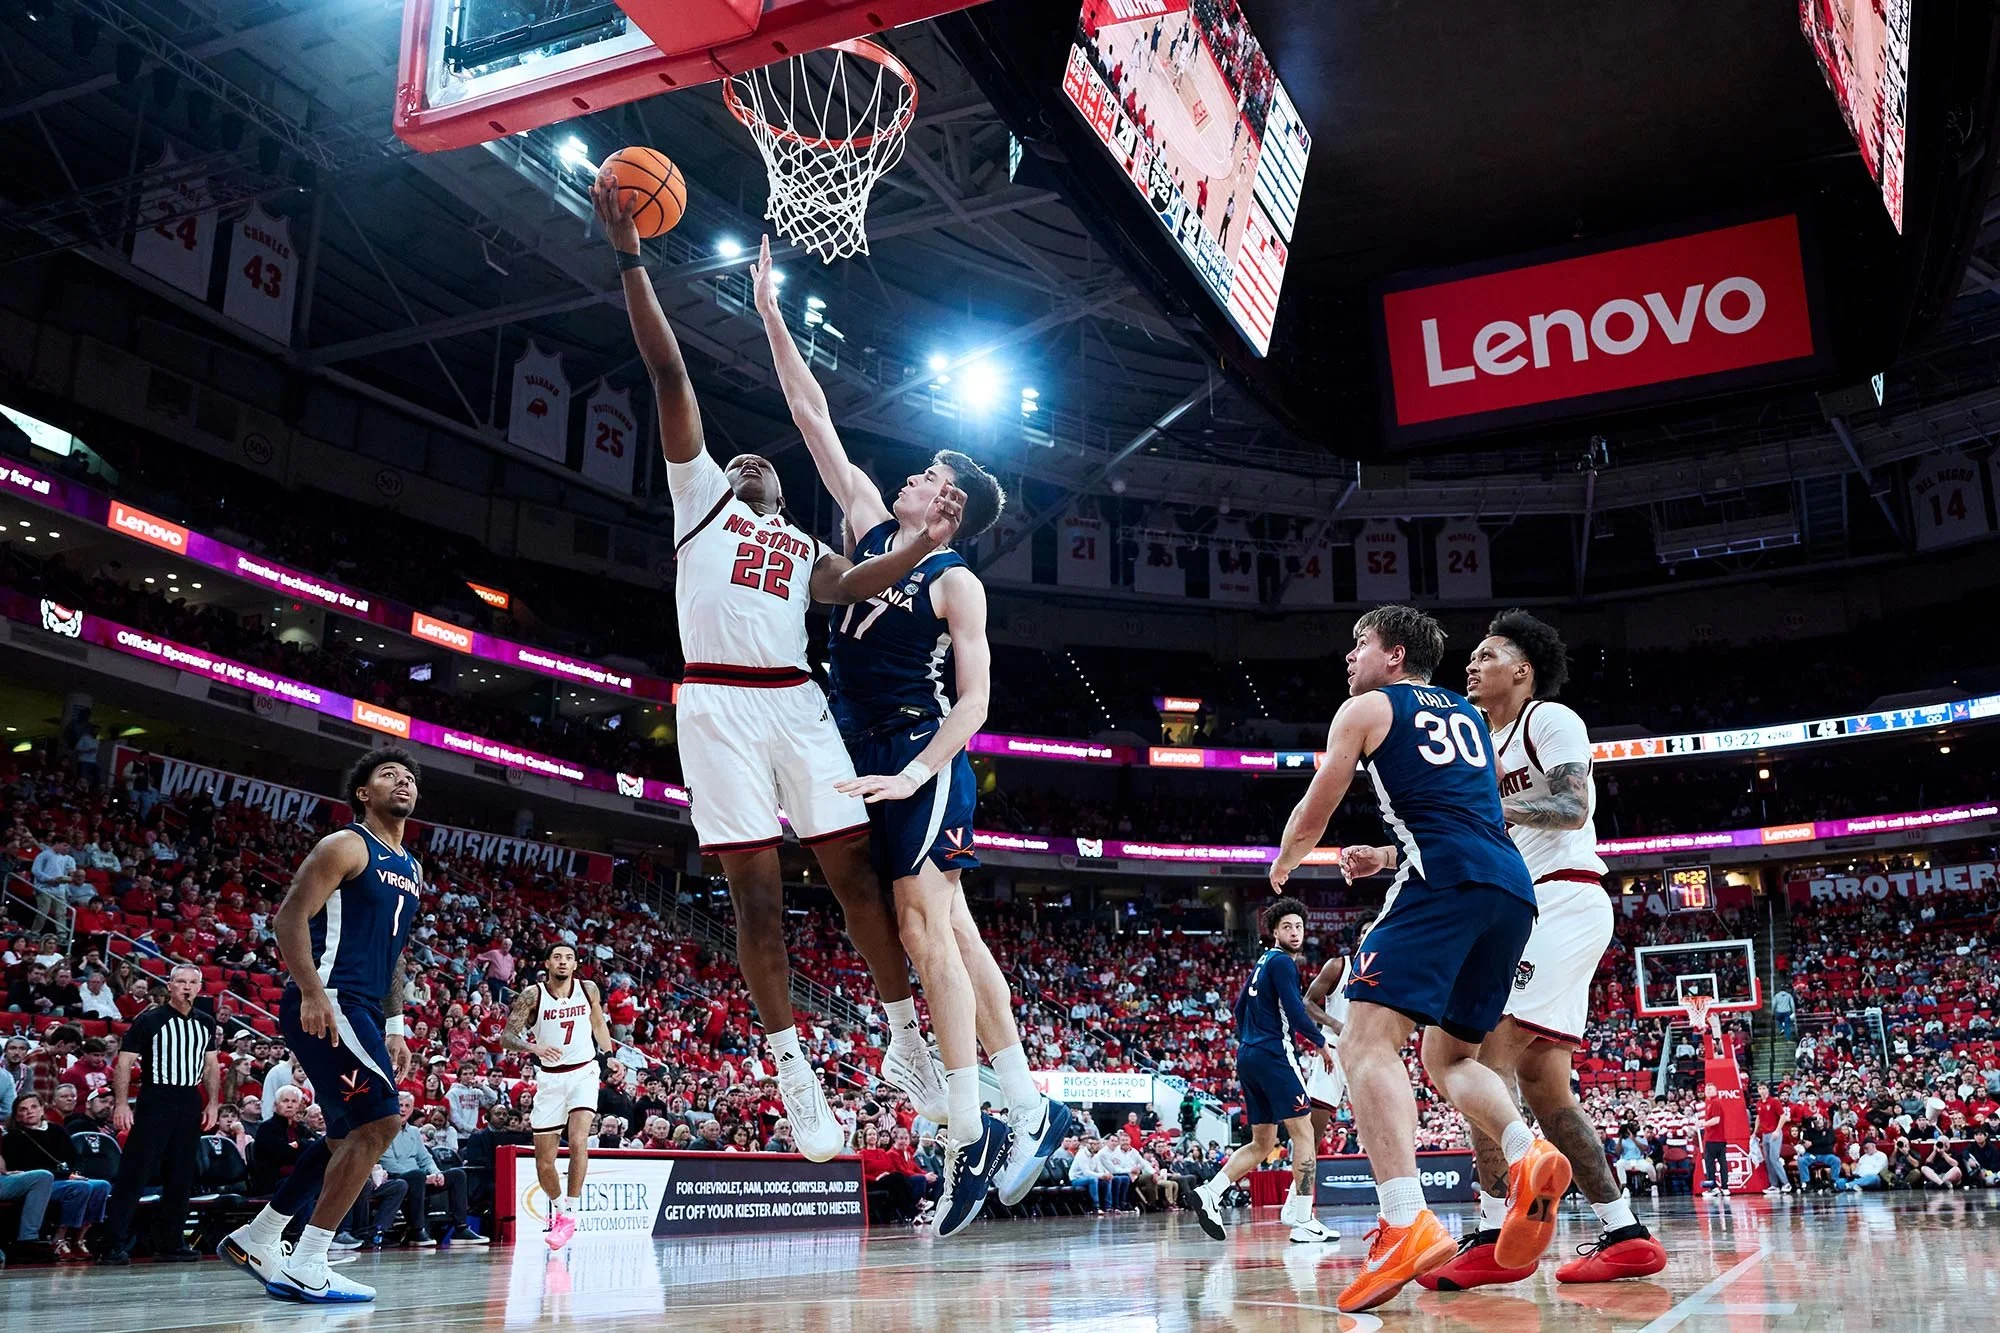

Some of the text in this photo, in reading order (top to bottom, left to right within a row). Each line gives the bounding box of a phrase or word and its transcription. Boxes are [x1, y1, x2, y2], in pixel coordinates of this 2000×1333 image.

[1117, 118, 1137, 152] 20
[1150, 169, 1171, 205] 19:22
[1183, 209, 1200, 243] 42
[244, 254, 282, 298] 43
[1421, 276, 1767, 388] Lenovo
[596, 422, 624, 458] 25
[10, 469, 33, 488] for
[32, 480, 50, 494] all
[1929, 488, 1967, 525] 14
[115, 507, 183, 546] Lenovo
[723, 513, 811, 562] NC STATE
[1071, 536, 1095, 561] 21
[731, 542, 794, 601] 22
[1367, 551, 1397, 574] 52
[1448, 551, 1478, 574] 24
[238, 556, 369, 613] Smarter technology for all
[473, 588, 506, 606] enovo
[839, 596, 888, 640] 17
[416, 618, 469, 647] Lenovo
[117, 630, 321, 705] Official Sponsor of NC State Athletics
[518, 649, 632, 689] Smarter technology for all
[255, 695, 273, 711] 106
[1167, 699, 1200, 711] Lenovo
[1412, 689, 1458, 710] HALL
[357, 705, 407, 732] Lenovo
[1414, 710, 1488, 769] 30
[1714, 731, 1761, 749] 19:22
[1816, 720, 1838, 738] 42
[443, 732, 584, 781] Proud to call North Carolina home
[1008, 740, 1113, 759] Smarter technology for all
[1153, 751, 1201, 764] Lenovo
[1240, 755, 1274, 766] Smarter
[160, 760, 320, 824] WOLFPACK
[664, 787, 689, 801] Offic
[1847, 805, 1999, 832] Proud to call North Carolina home
[972, 833, 1049, 851] orth Carolina home
[1611, 842, 1646, 853] Sponsor
[1645, 840, 1656, 850] of
[1656, 838, 1672, 849] NC
[1671, 837, 1694, 847] State
[1694, 834, 1733, 845] Athletics
[1764, 827, 1812, 842] Lenovo
[430, 827, 577, 878] BASKETBALL
[1123, 844, 1266, 860] Official Sponsor of NC State Athletics
[1303, 850, 1338, 862] enovo
[376, 868, 420, 900] VIRGINIA
[1672, 870, 1707, 885] 19:22
[1684, 884, 1706, 907] 10
[392, 894, 405, 937] 1
[543, 1004, 587, 1021] NC STATE
[560, 1020, 575, 1045] 7
[1063, 1076, 1146, 1088] RIGGS HARROD
[1063, 1088, 1111, 1098] BUILDERS
[1717, 1089, 1740, 1099] PNC
[676, 1181, 860, 1197] FOR CHEVROLET, RAM, DODGE, CHRYSLER, AND JEEP
[1325, 1174, 1374, 1182] CHRYSL
[1420, 1168, 1461, 1189] eep
[578, 1183, 649, 1212] IESTER
[665, 1201, 861, 1221] GET OFF YOUR KIESTER AND COME TO HIESTER
[579, 1216, 650, 1232] AUTOMOTIVE
